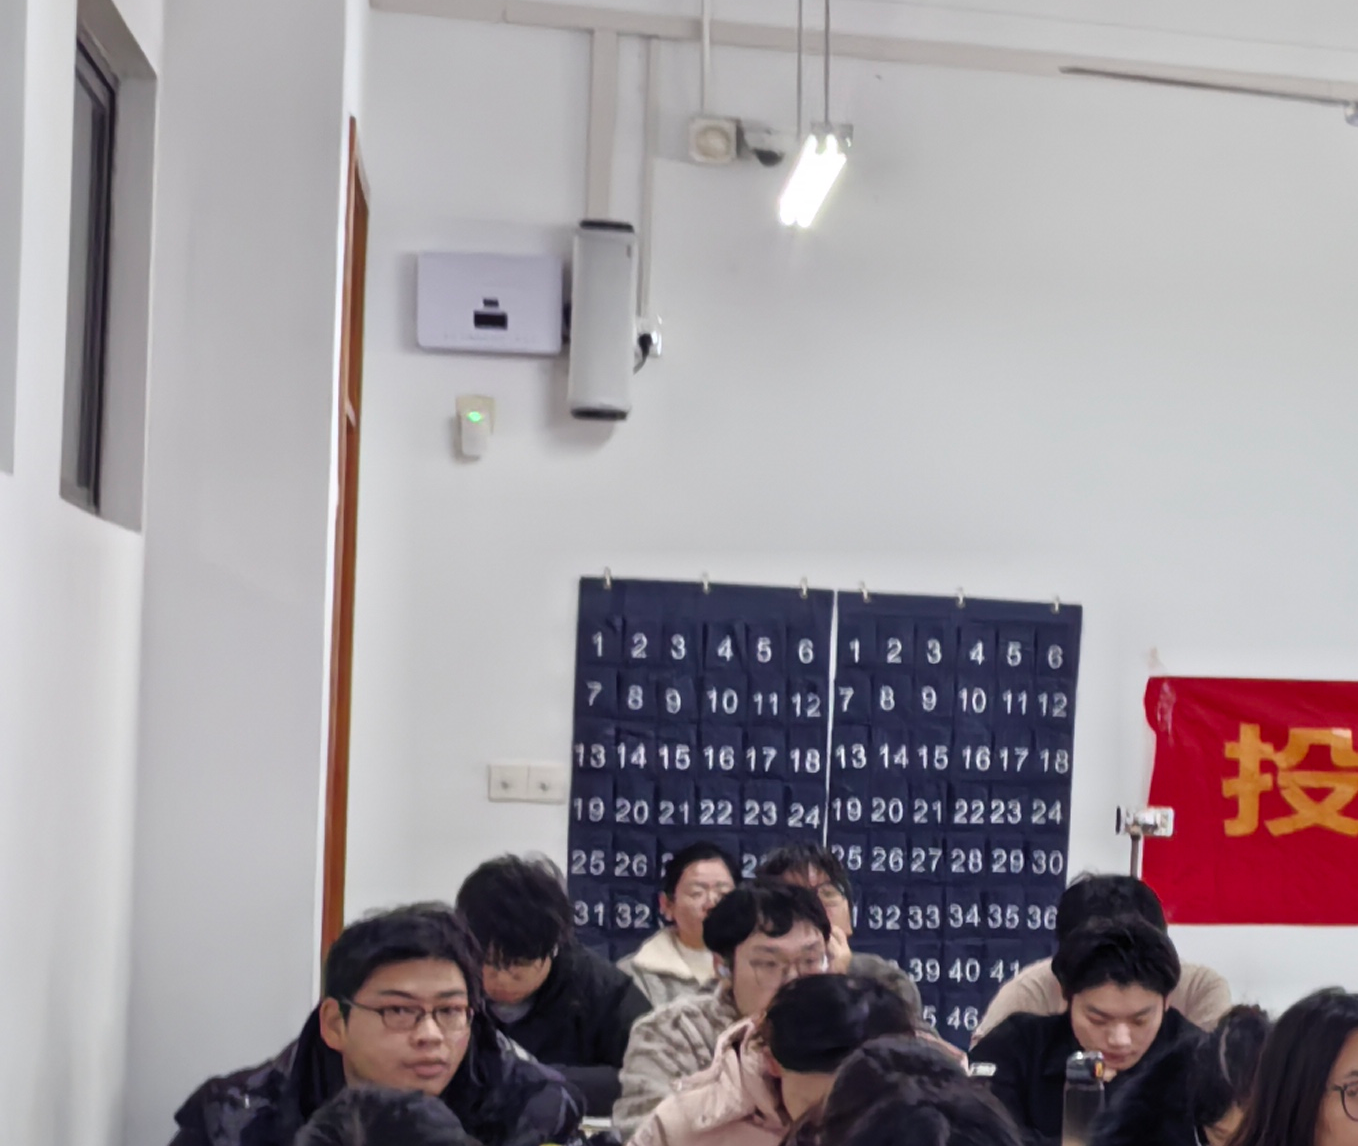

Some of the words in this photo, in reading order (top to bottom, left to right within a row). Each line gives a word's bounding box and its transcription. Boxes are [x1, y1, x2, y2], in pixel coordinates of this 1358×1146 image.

[592, 632, 604, 657] 1
[631, 633, 648, 659] 2
[671, 634, 686, 660] 3
[717, 636, 733, 661] 4
[756, 637, 772, 663] 5
[798, 639, 814, 664] 6
[848, 638, 860, 664] 1
[886, 637, 903, 664] 2
[926, 639, 942, 664] 3
[969, 641, 985, 665] 4
[1006, 641, 1022, 666] 5
[1047, 646, 1063, 669] 6
[587, 682, 602, 707] 7
[627, 685, 643, 710] 8
[665, 689, 682, 714] 9
[708, 688, 738, 714] 10
[754, 692, 778, 716] 11
[792, 692, 821, 718] 12
[839, 687, 854, 712] 7
[879, 686, 895, 711] 8
[921, 686, 937, 712] 9
[959, 687, 987, 714] 10
[1003, 690, 1027, 715] 11
[1039, 693, 1068, 717] 12
[574, 742, 606, 769] 13
[617, 742, 647, 768] 14
[659, 744, 691, 770] 15
[704, 746, 735, 771] 16
[746, 747, 777, 772] 17
[790, 748, 821, 774] 18
[836, 743, 867, 769] 13
[879, 743, 909, 769] 14
[918, 745, 949, 770] 15
[962, 745, 991, 771] 16
[1000, 747, 1029, 772] 17
[1040, 749, 1069, 774] 18
[574, 797, 605, 822] 19
[615, 799, 649, 824] 20
[659, 801, 689, 824] 21
[700, 799, 733, 825] 22
[744, 800, 778, 826] 23
[787, 803, 820, 829] 24
[833, 797, 862, 822] 19
[871, 797, 904, 823] 20
[913, 799, 942, 823] 21
[953, 798, 985, 824] 22
[990, 799, 1022, 824] 23
[1031, 801, 1062, 824] 24
[571, 851, 605, 875] 25
[614, 853, 647, 876] 26
[871, 846, 904, 872] 26
[911, 847, 942, 873] 27
[951, 848, 983, 873] 28
[992, 848, 1024, 873] 29
[1032, 850, 1064, 874] 30
[574, 901, 604, 926] 31
[616, 904, 650, 927] 32
[869, 905, 901, 930] 32
[908, 905, 940, 930] 33
[949, 904, 981, 928] 34
[987, 905, 1020, 929] 35
[1027, 905, 1058, 930] 36
[908, 957, 941, 983] 39
[948, 958, 981, 983] 40
[947, 1005, 979, 1031] 46
